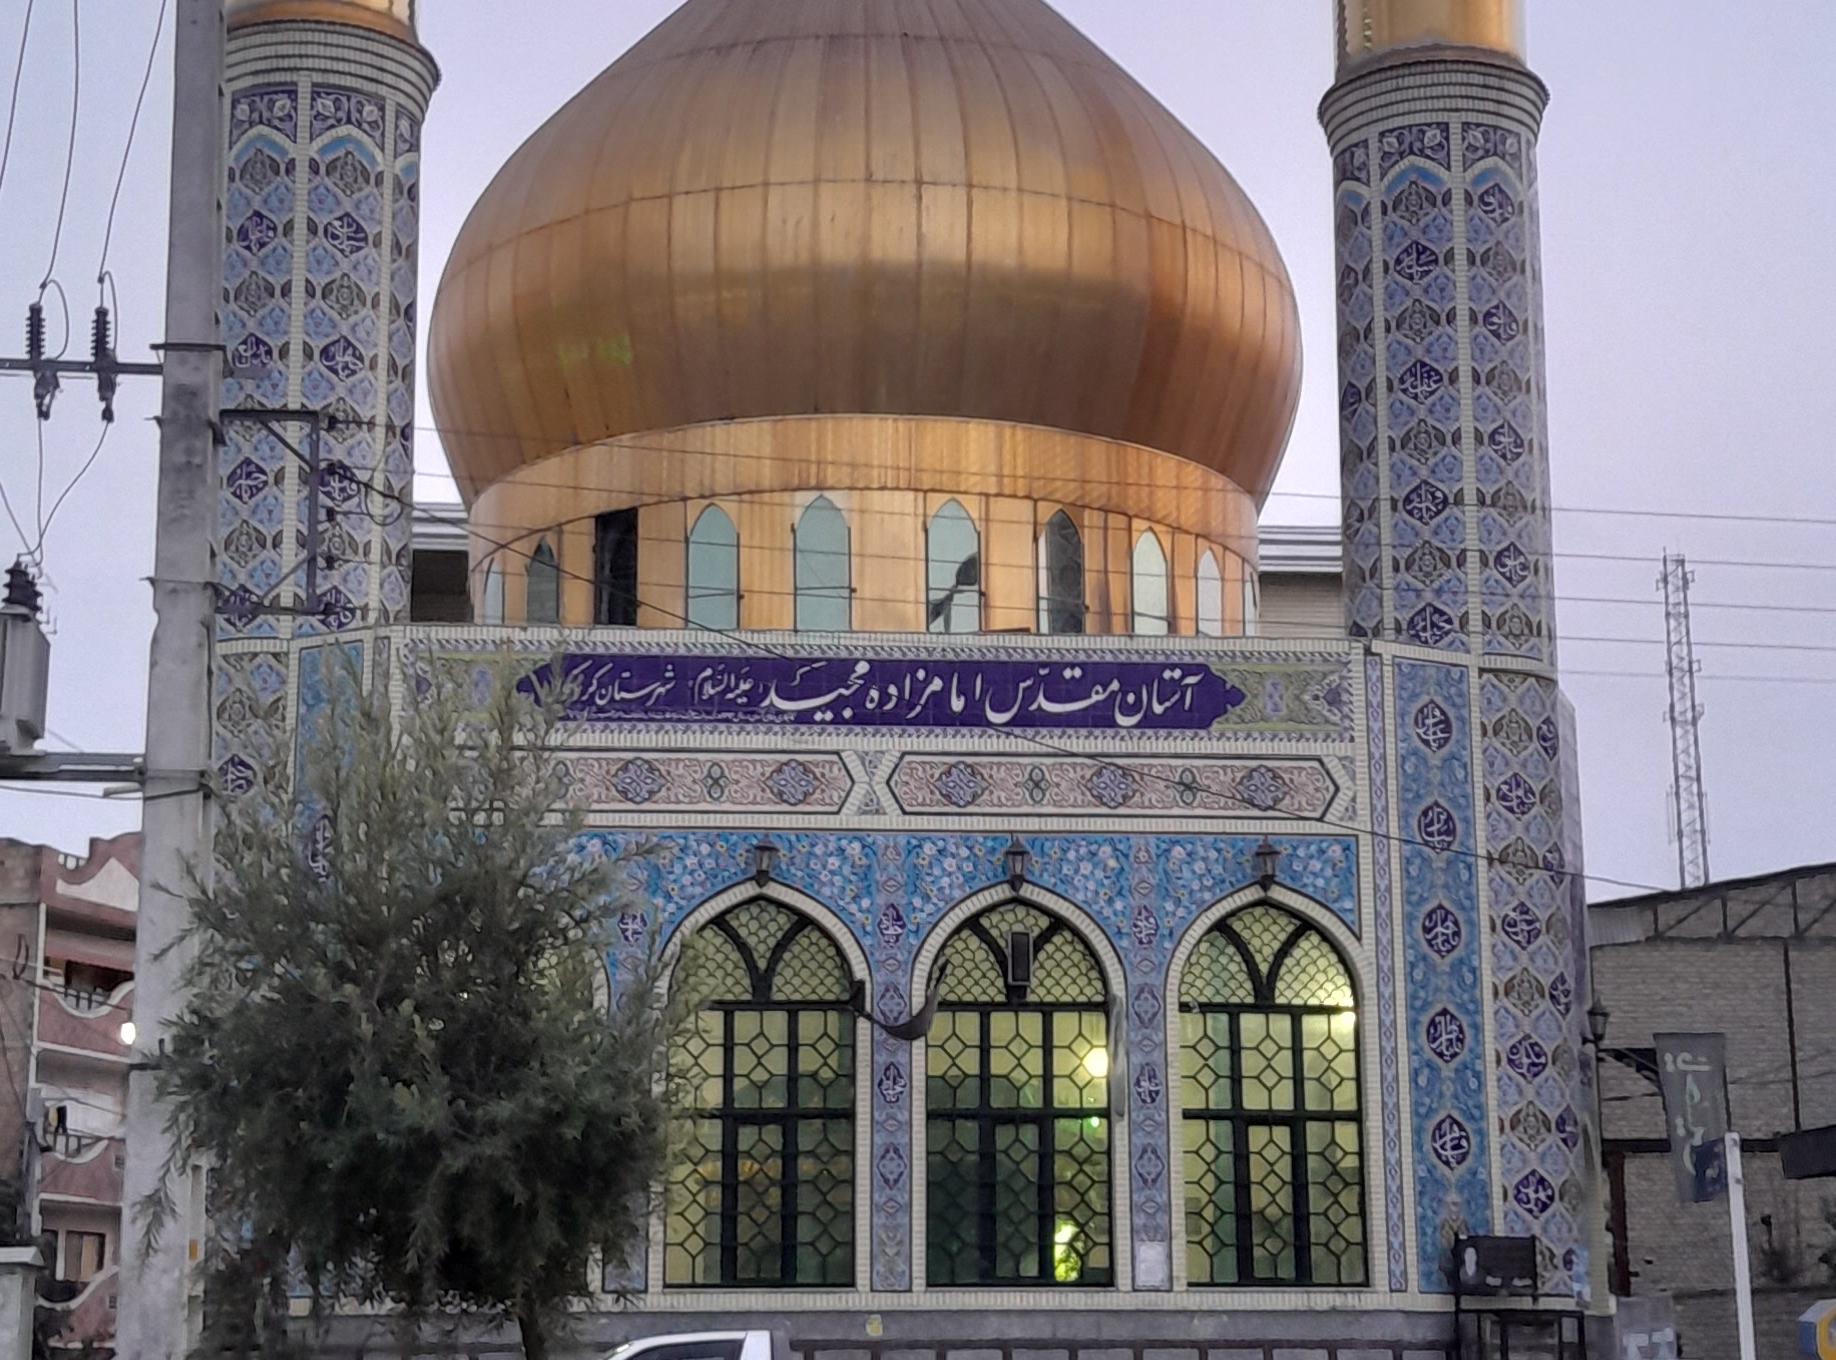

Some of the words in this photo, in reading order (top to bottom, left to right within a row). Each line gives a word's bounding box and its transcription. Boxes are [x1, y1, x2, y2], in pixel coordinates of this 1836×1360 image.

[595, 664, 677, 706] شهرستان
[760, 660, 870, 720] مجید
[865, 668, 983, 719] امامزاده
[1114, 667, 1204, 727] آستان
